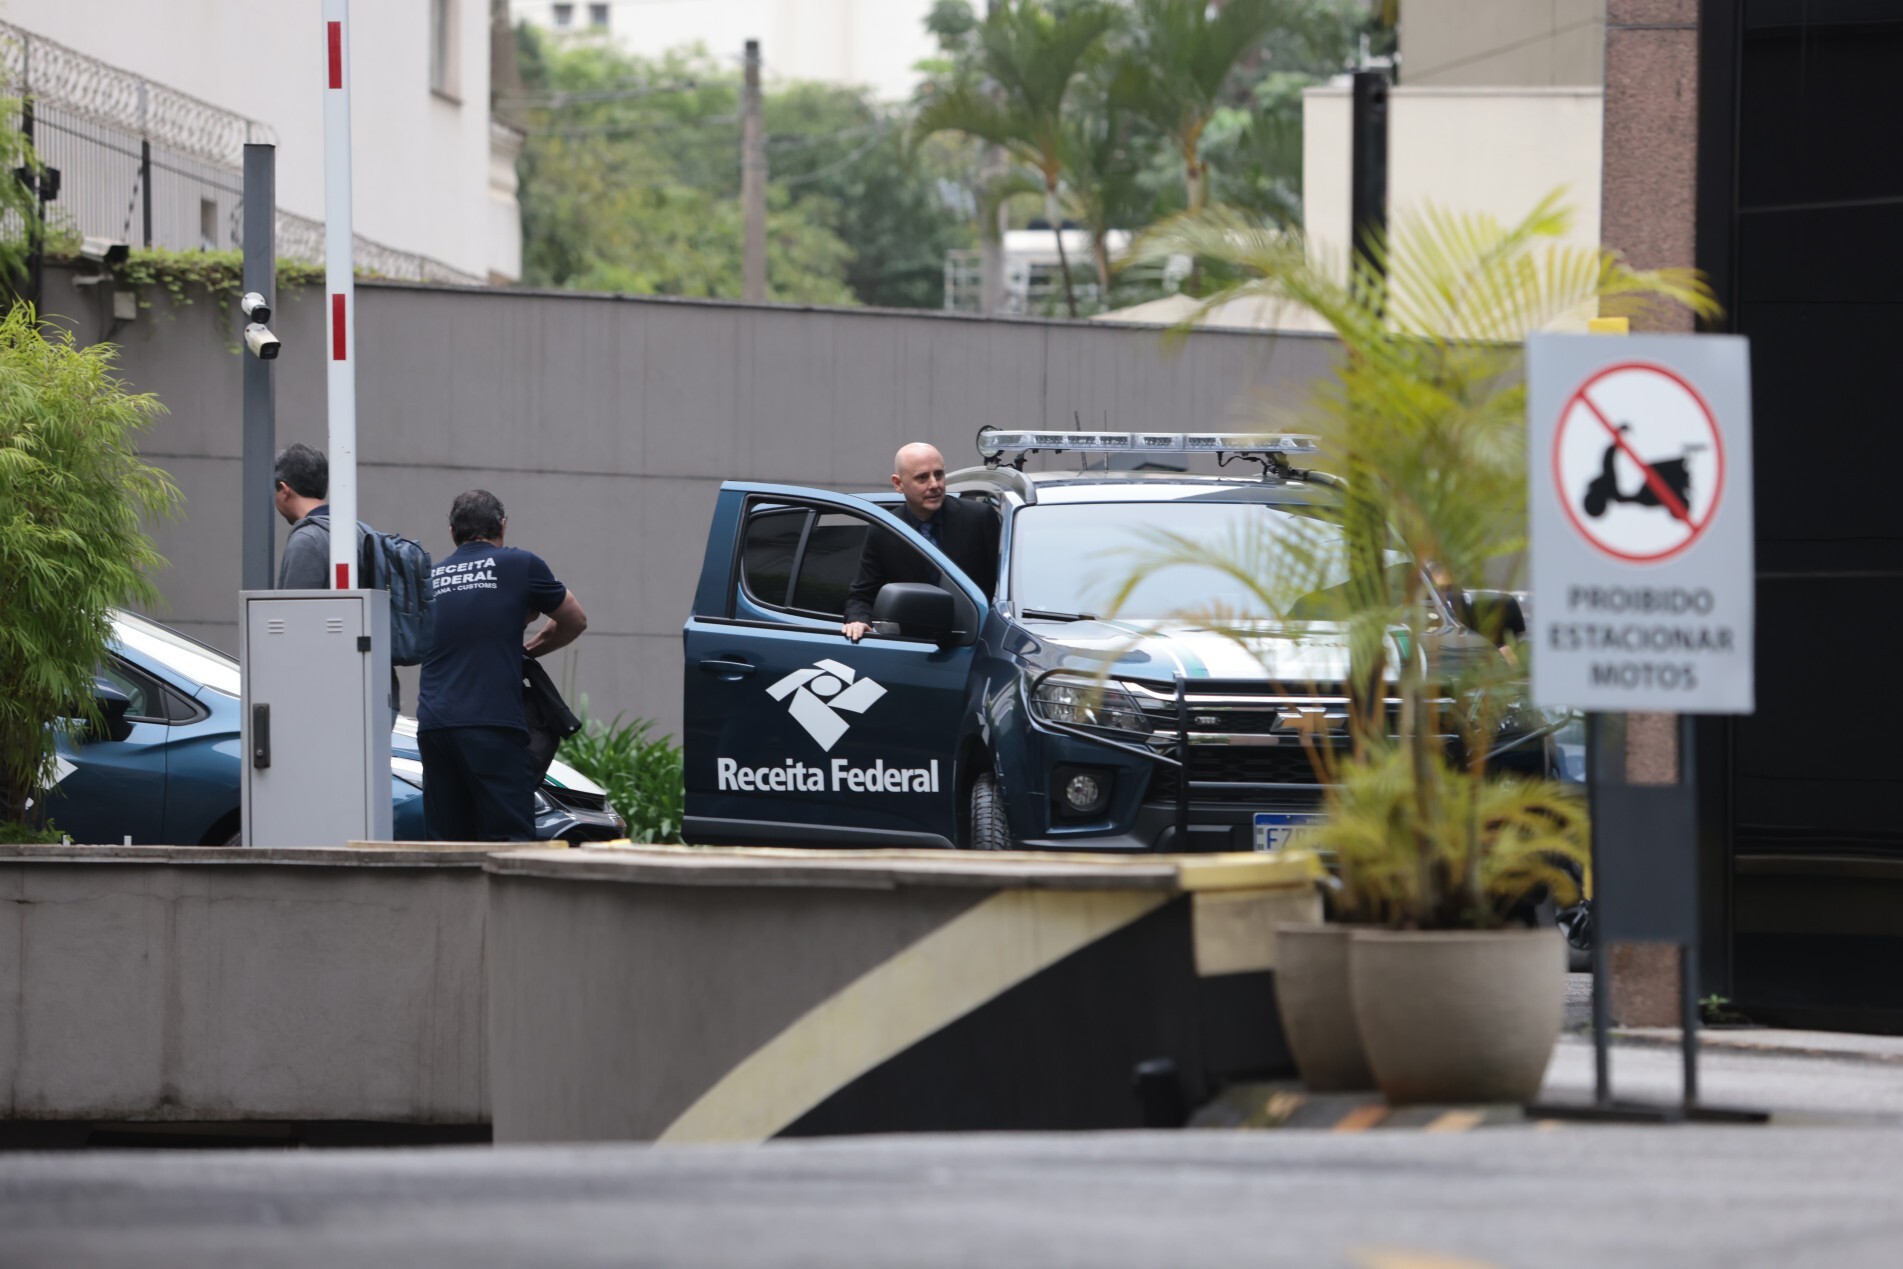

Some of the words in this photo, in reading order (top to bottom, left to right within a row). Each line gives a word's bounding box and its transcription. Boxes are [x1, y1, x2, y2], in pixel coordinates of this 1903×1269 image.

[432, 570, 498, 589] EDERAL
[457, 583, 498, 591] CUSTOMS
[1567, 585, 1715, 615] PROIBIDO
[1549, 623, 1736, 653] ESTACIONAR
[1590, 660, 1699, 691] MOTOS
[717, 757, 825, 791] Receita
[831, 758, 940, 792] Federal
